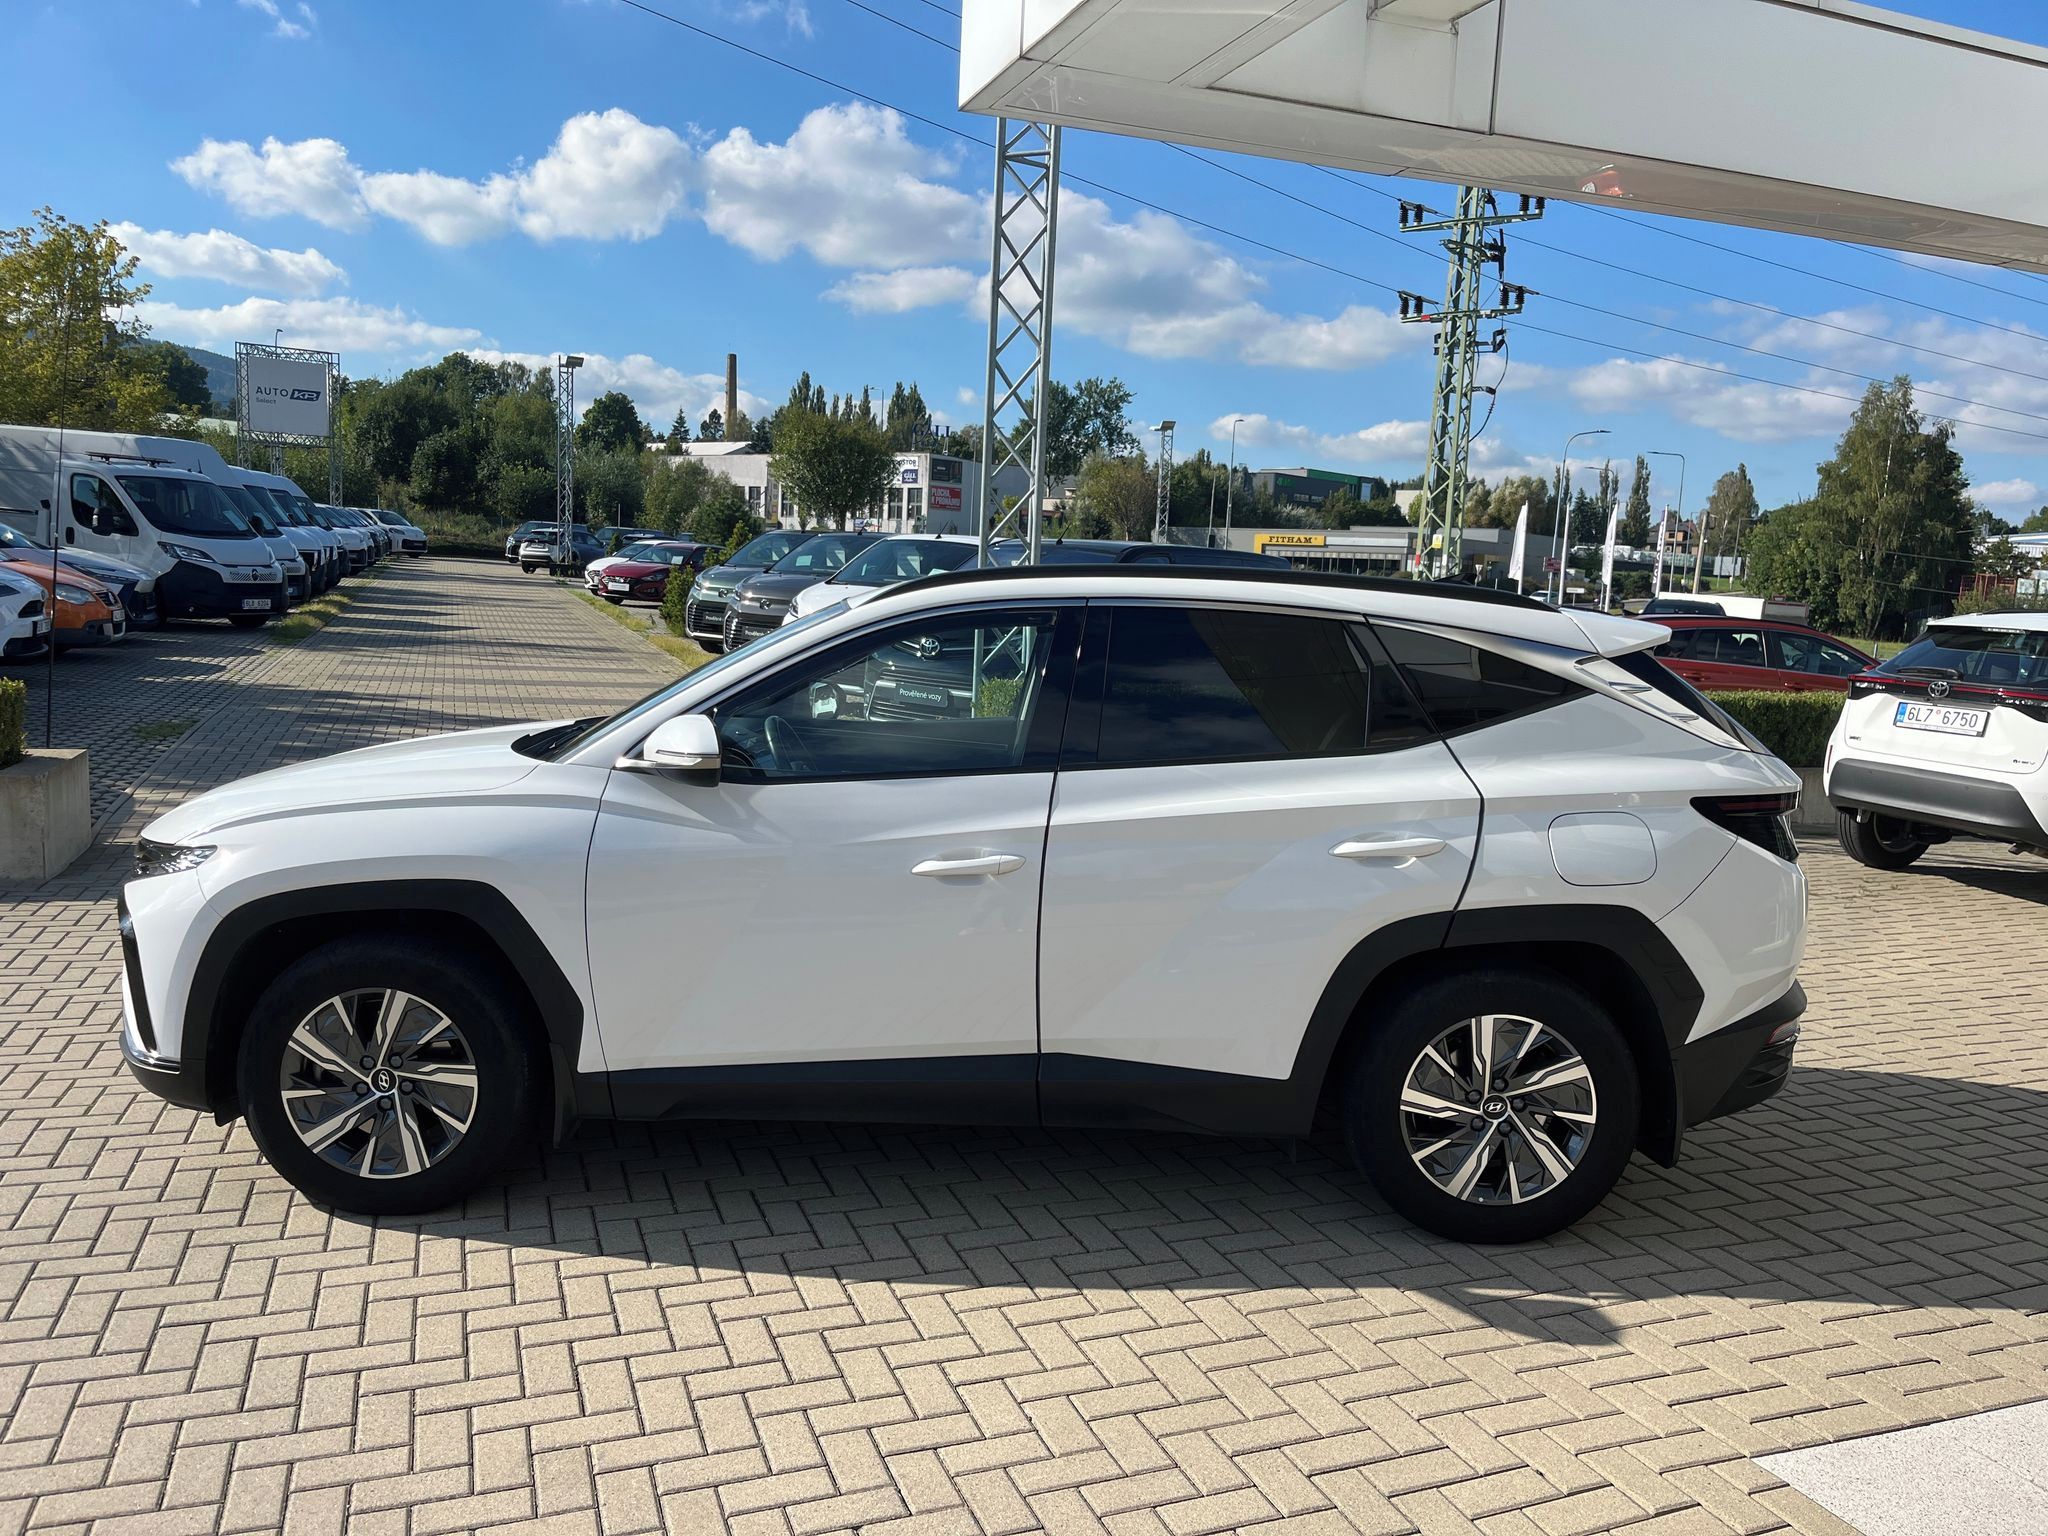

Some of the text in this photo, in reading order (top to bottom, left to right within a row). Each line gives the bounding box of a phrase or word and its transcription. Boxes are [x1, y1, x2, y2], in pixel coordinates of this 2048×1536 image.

[255, 386, 289, 397] AUTO
[1268, 536, 1313, 544] FITHAM
[899, 688, 942, 702] Prověřené vozy
[1907, 707, 1934, 722] 6L7
[1942, 711, 1979, 728] 6750
